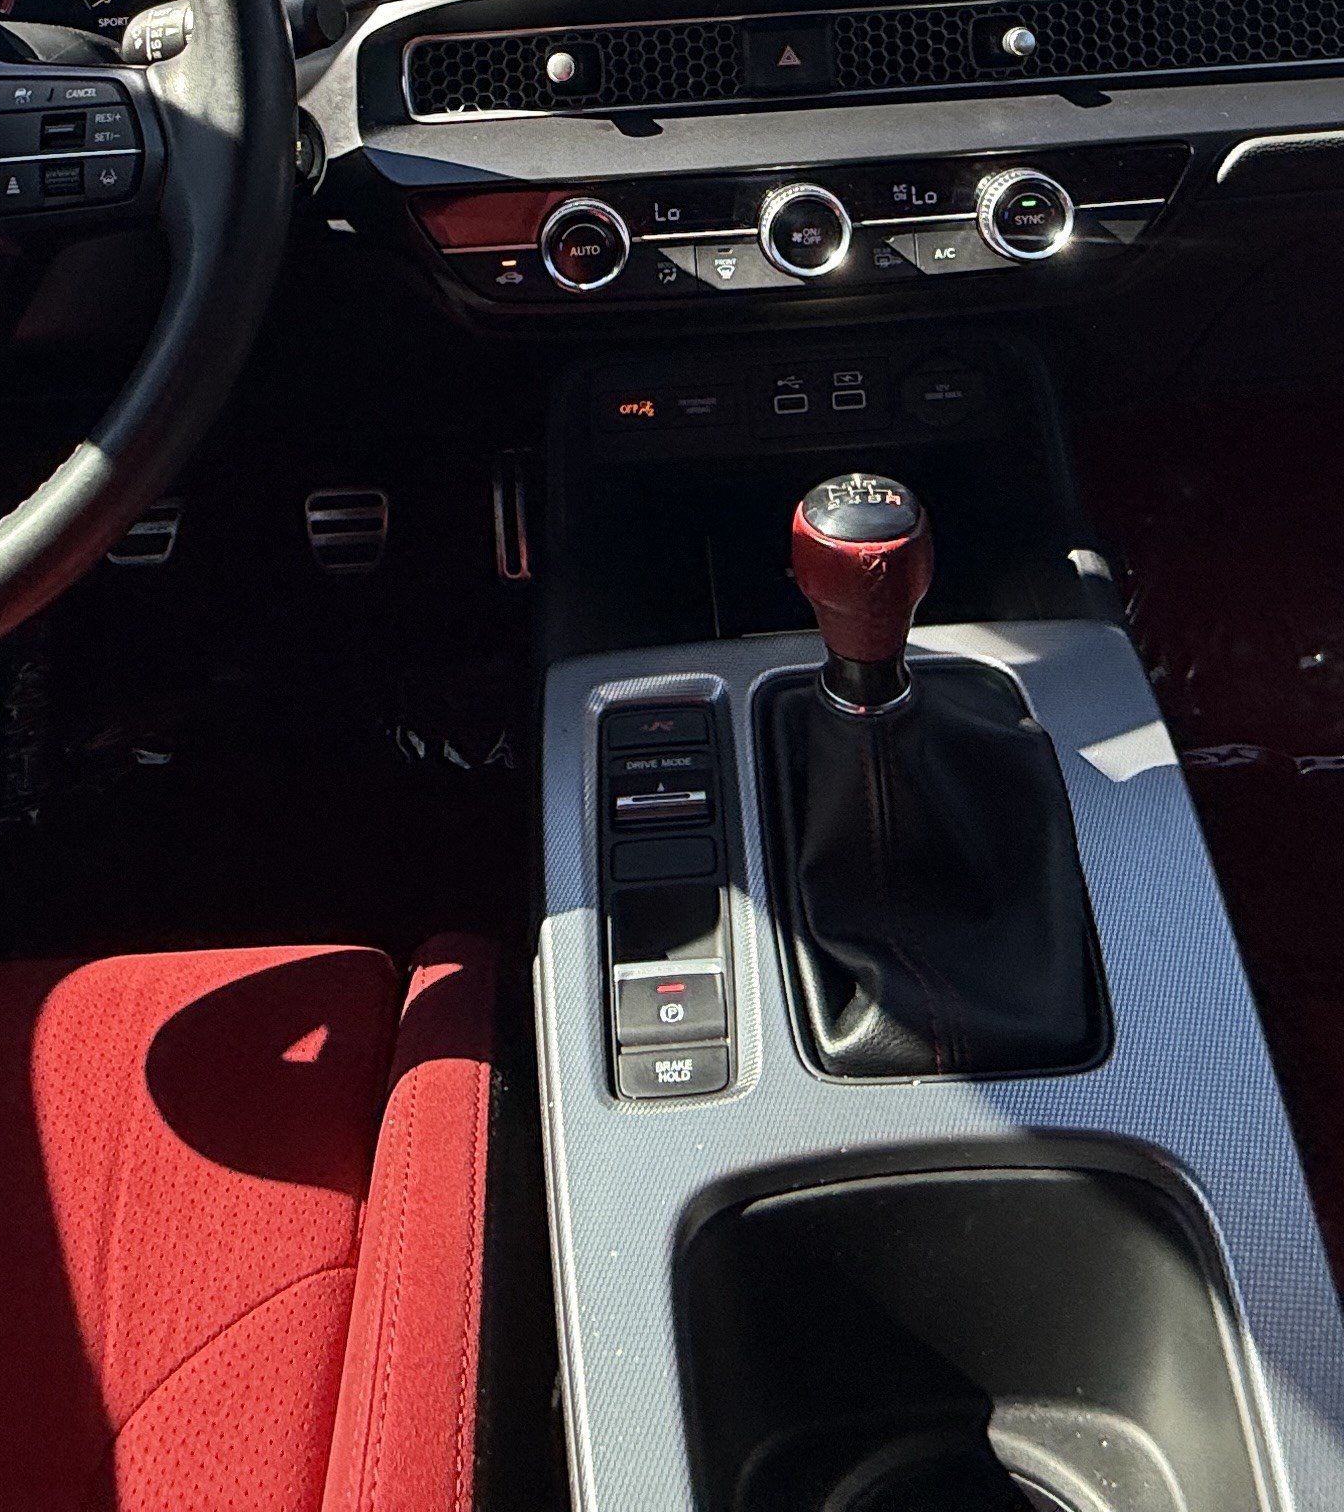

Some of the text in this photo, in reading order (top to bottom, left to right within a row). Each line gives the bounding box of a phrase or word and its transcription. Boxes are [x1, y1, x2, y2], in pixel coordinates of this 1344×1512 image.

[98, 17, 129, 28] SPORT
[65, 87, 98, 99] CANCEL
[911, 185, 937, 205] Lo
[654, 202, 681, 222] Lo
[1014, 213, 1046, 226] SYNC
[569, 245, 601, 257] AUTO
[934, 247, 956, 260] A/C
[626, 757, 692, 770] DRIVE MODE
[655, 1059, 693, 1073] BRAKE
[658, 1070, 691, 1083] HOLD
